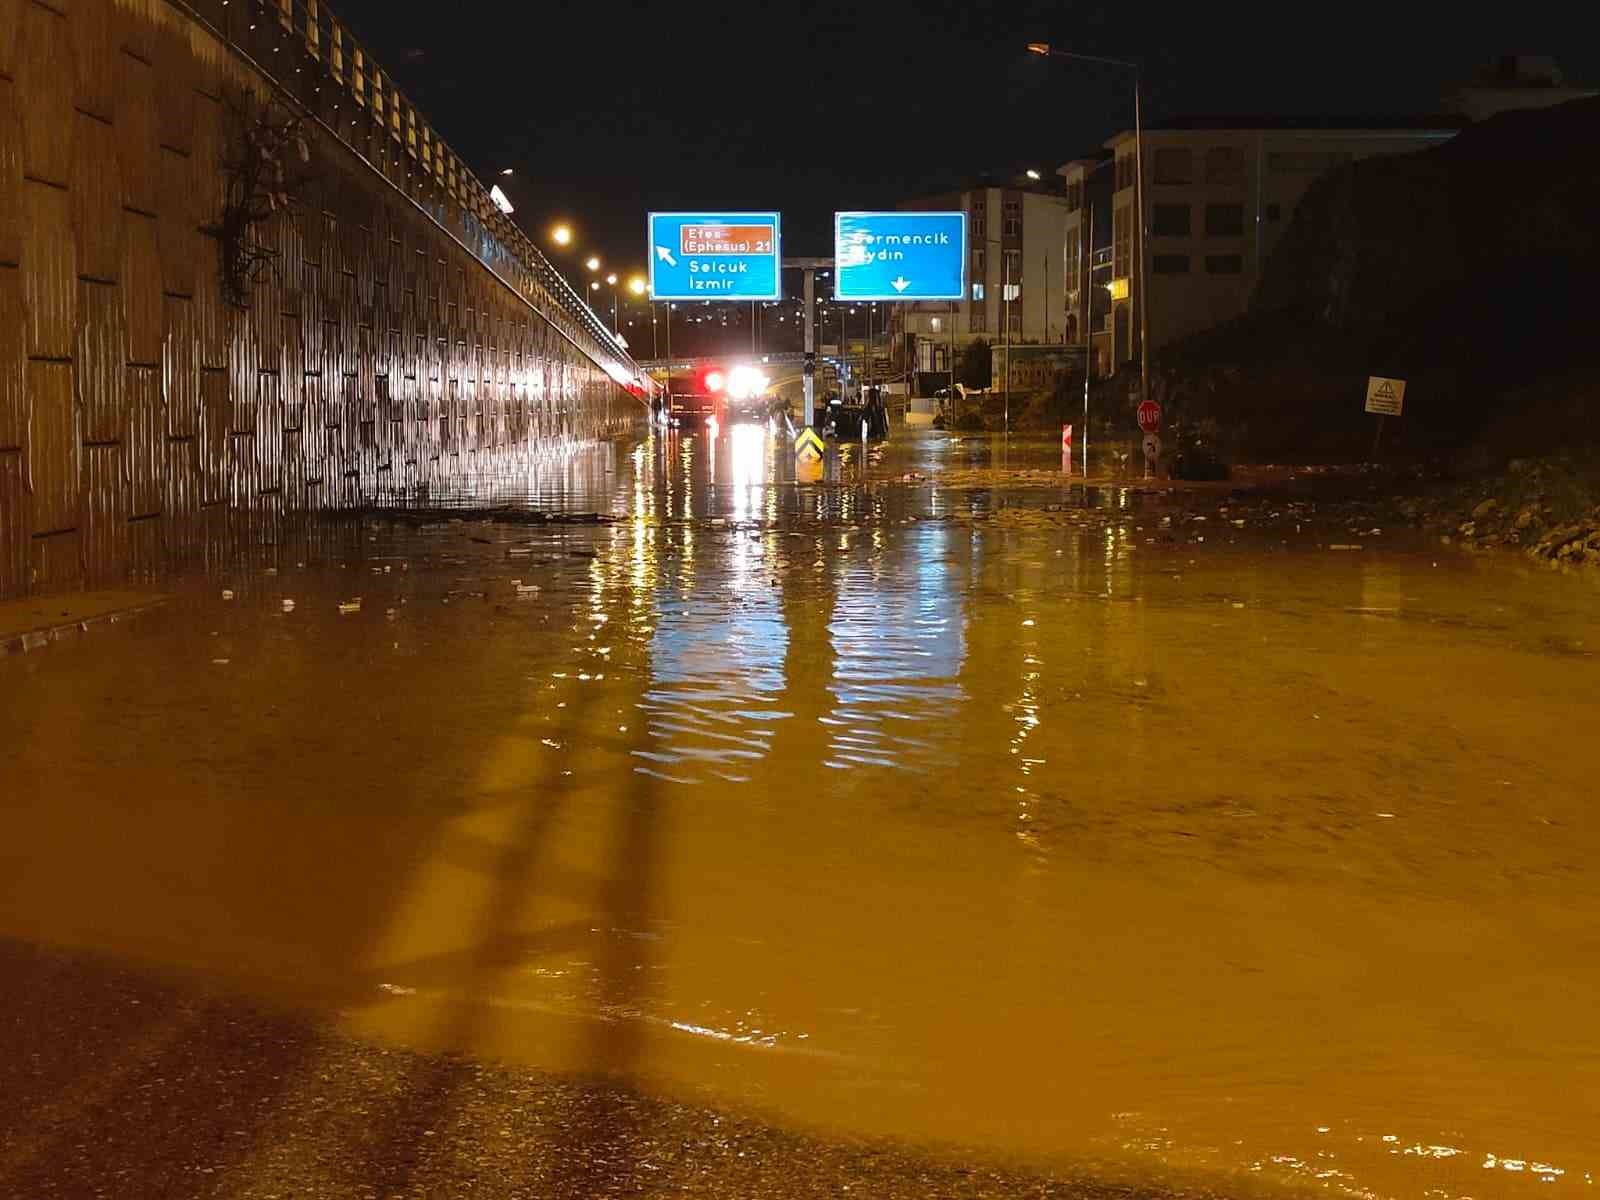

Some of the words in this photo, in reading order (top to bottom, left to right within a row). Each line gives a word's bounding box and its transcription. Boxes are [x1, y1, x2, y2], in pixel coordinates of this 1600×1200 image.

[688, 228, 722, 239] Efes
[684, 240, 750, 253] (Ephesus)
[755, 241, 771, 251] 21
[852, 248, 904, 263] ydın
[689, 260, 747, 274] Selçuk
